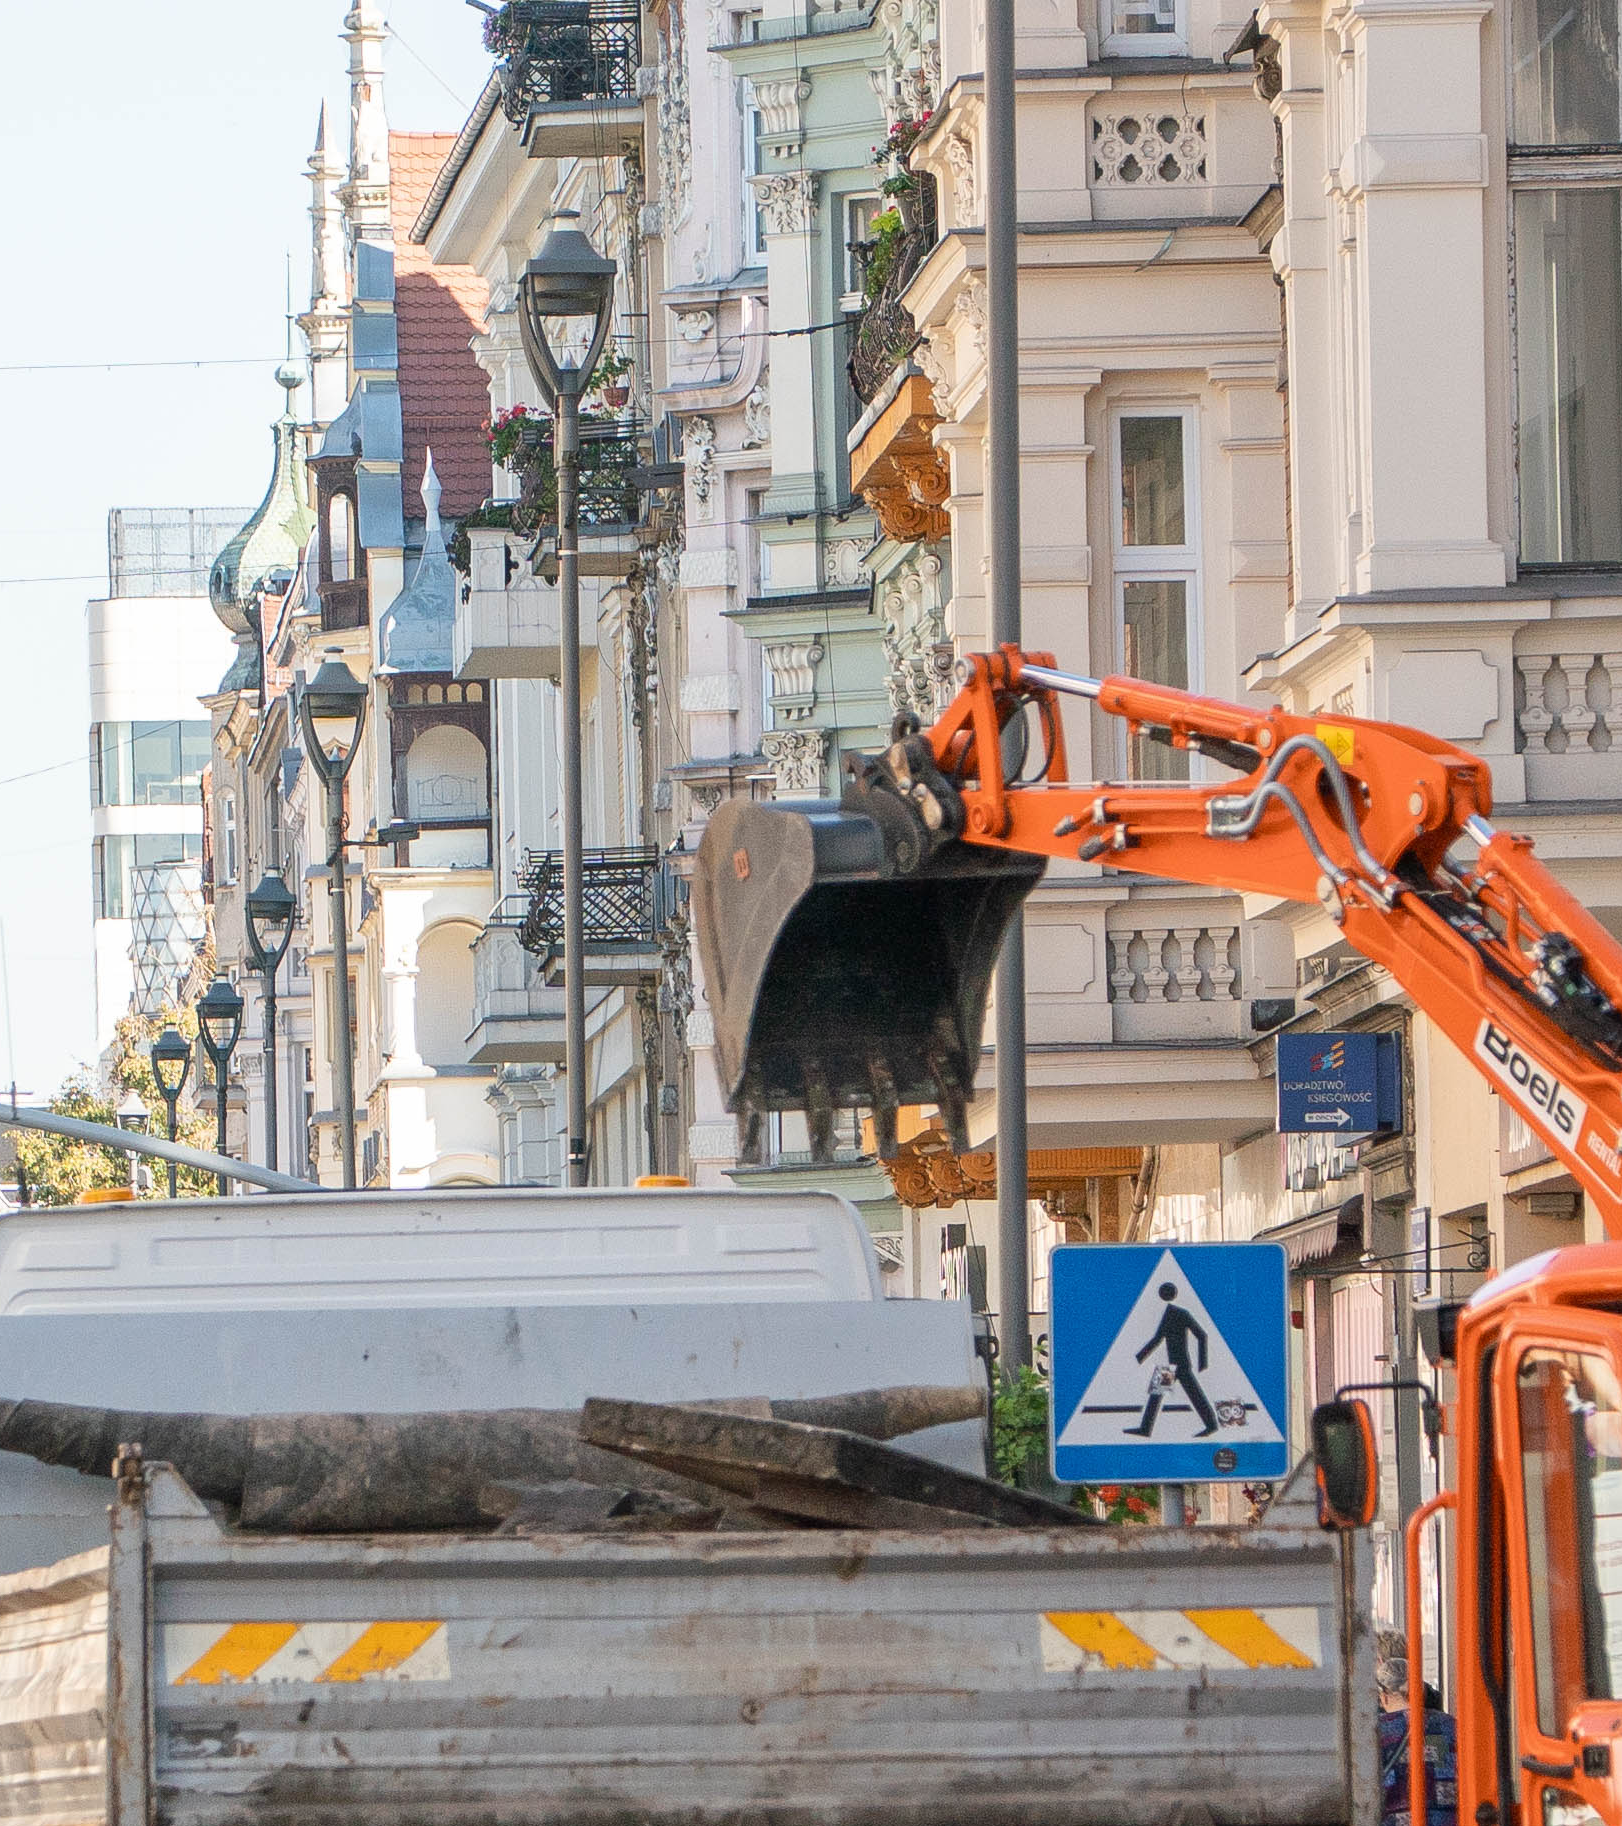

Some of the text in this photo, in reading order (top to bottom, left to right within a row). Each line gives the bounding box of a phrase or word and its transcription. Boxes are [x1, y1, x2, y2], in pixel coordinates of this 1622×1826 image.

[1283, 1080, 1344, 1091] DORADZTWO
[1483, 1022, 1576, 1135] Boels
[1588, 1130, 1622, 1178] RENTAL
